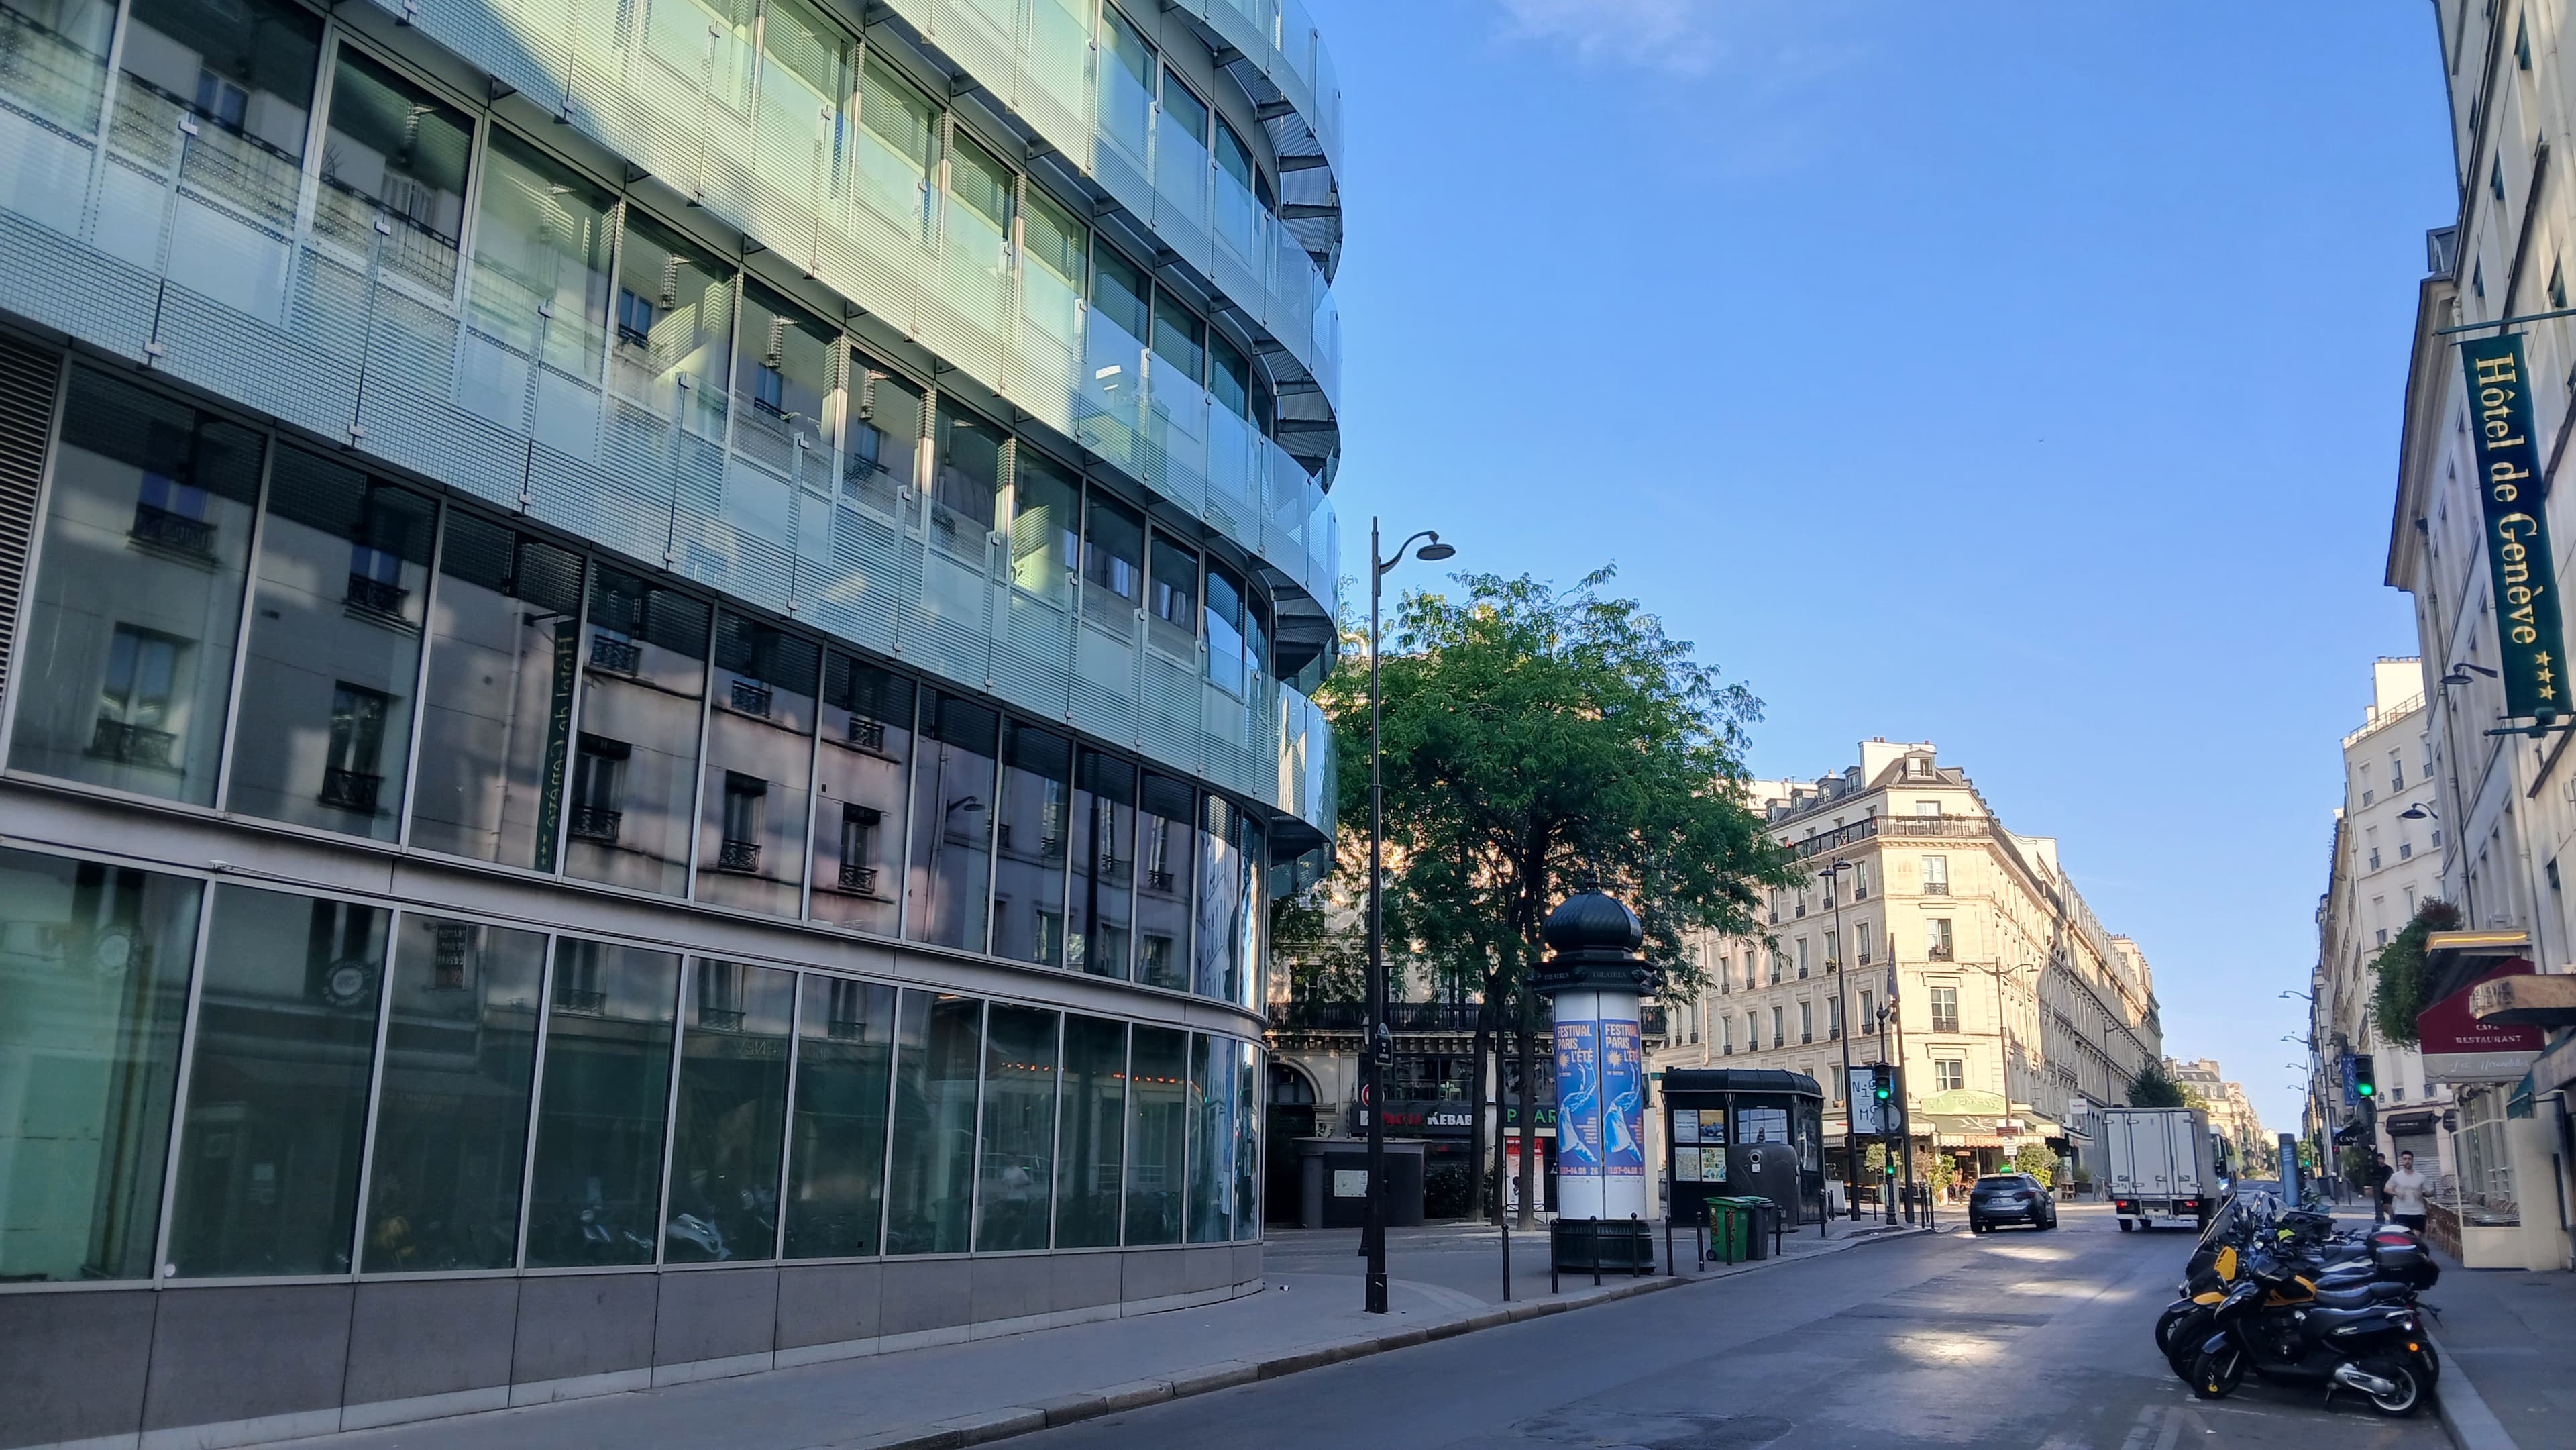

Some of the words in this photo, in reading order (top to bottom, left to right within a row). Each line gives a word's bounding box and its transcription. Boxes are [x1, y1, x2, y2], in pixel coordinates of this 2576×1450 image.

[2476, 352, 2525, 451] Hôtel
[2490, 462, 2530, 503] de
[2499, 512, 2544, 645] Genève
[1557, 1024, 1593, 1038] FESTIVAL
[1605, 1023, 1638, 1037] FESTIVAL
[1557, 1037, 1578, 1051] PARIS
[1605, 1037, 1630, 1049] PARIS
[2455, 1035, 2522, 1044] RESTAURANT
[1427, 1111, 1472, 1125] KEBAB
